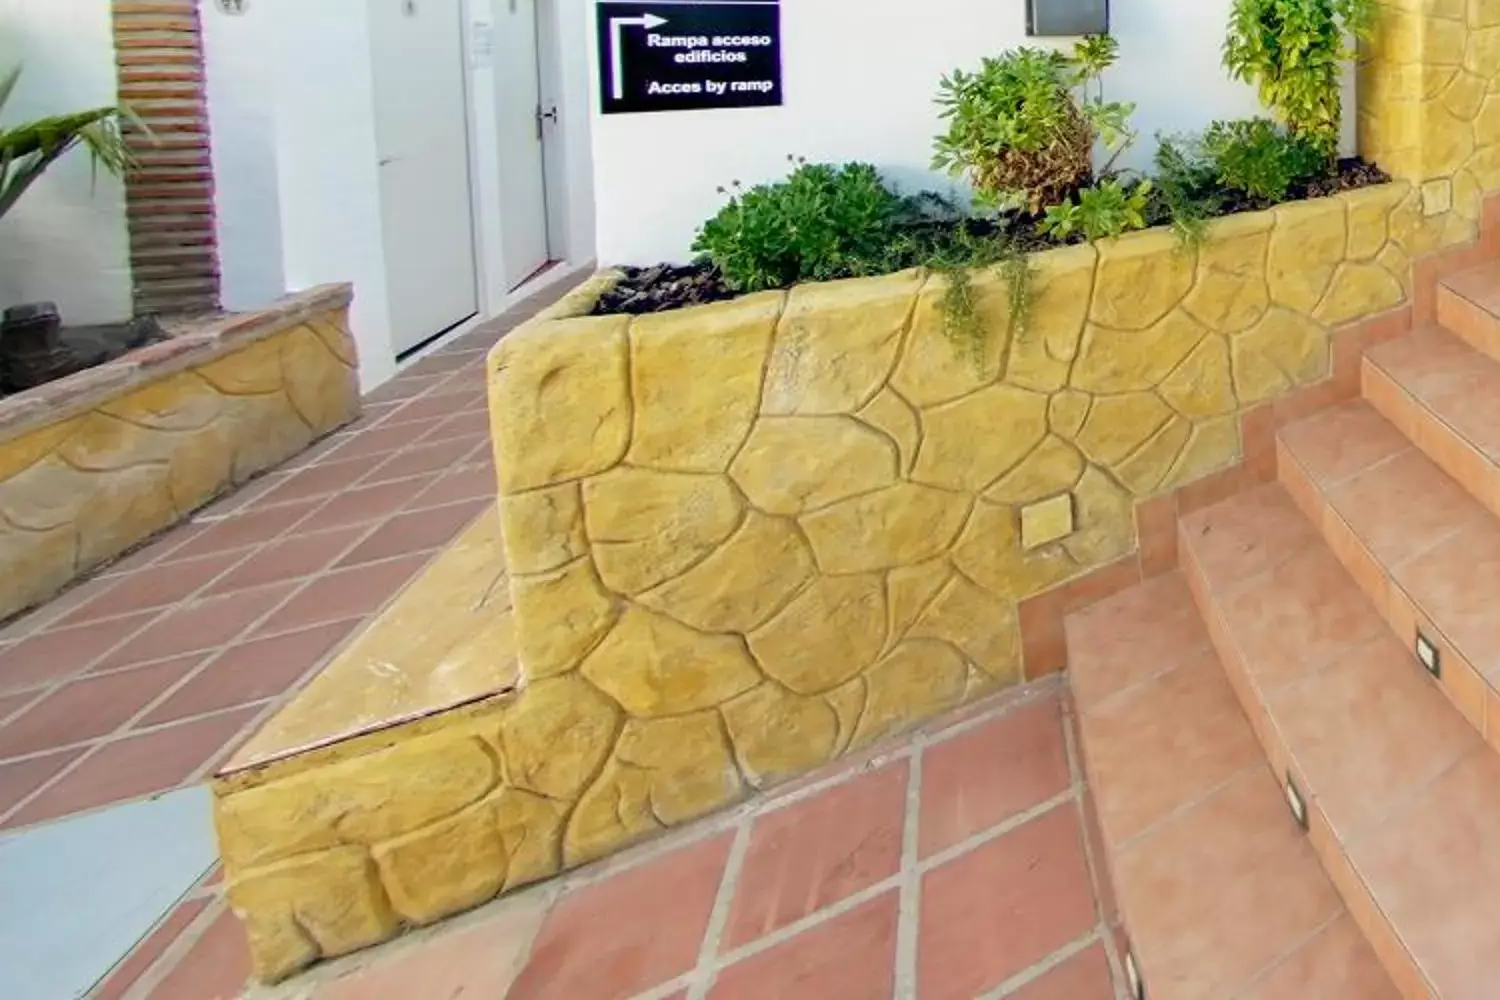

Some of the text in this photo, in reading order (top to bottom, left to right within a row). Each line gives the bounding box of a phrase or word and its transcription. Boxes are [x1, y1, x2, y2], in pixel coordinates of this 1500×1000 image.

[647, 33, 771, 49] Rampa acceso
[674, 50, 747, 63] edificios
[647, 80, 773, 95] Acces by ramp
